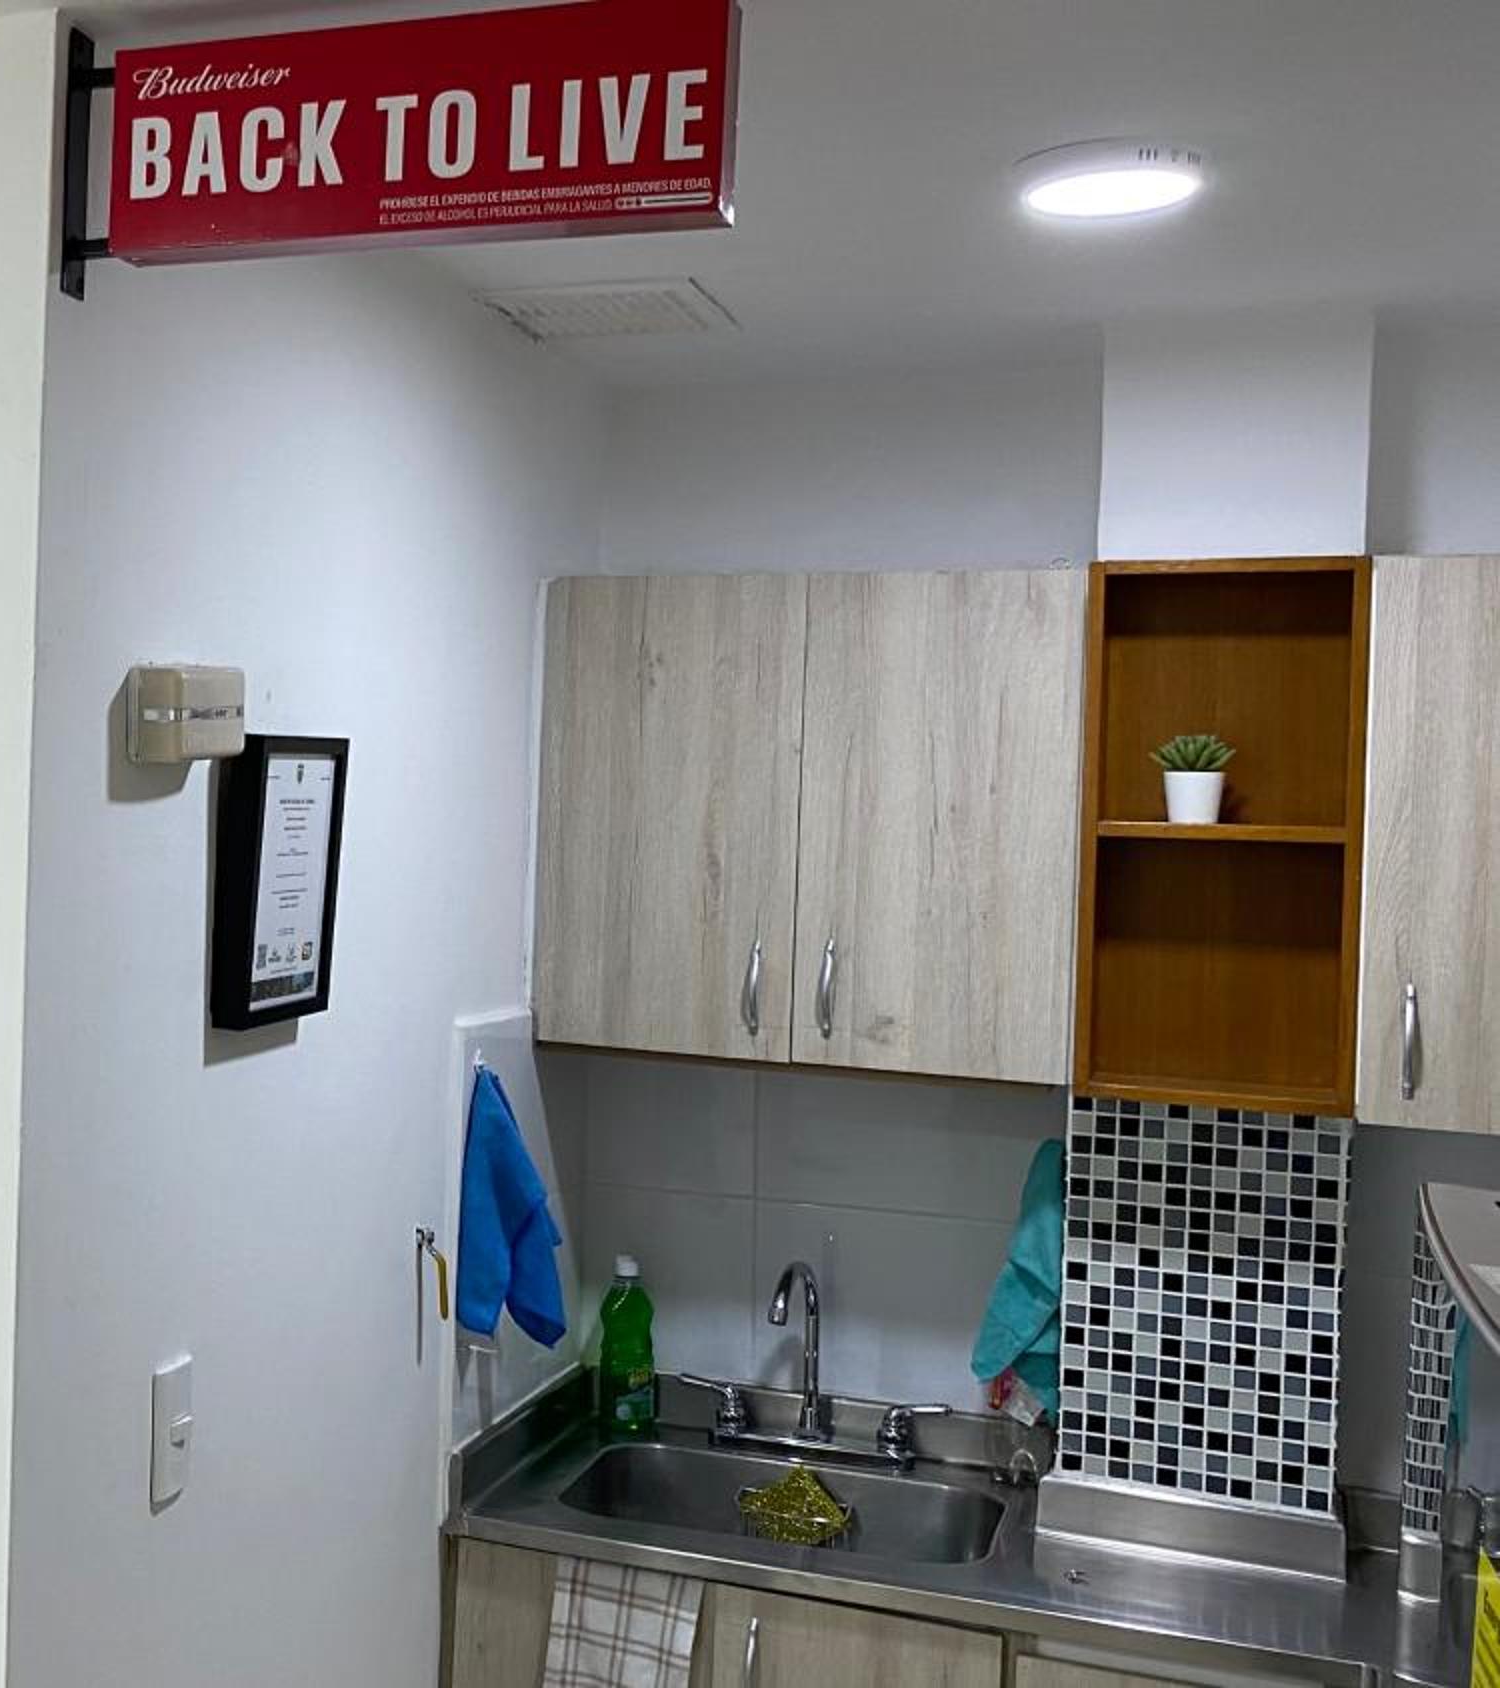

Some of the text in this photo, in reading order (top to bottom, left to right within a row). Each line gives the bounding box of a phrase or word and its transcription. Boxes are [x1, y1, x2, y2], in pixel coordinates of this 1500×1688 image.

[133, 64, 291, 100] Budweiser
[130, 69, 707, 199] BACK TO LIVE
[430, 195, 441, 206] EL
[488, 191, 500, 203] DE
[501, 188, 540, 202] BEBIDAS
[614, 184, 621, 195] A
[622, 180, 668, 194] MENORES
[670, 179, 682, 191] DE
[569, 200, 580, 212] LA
